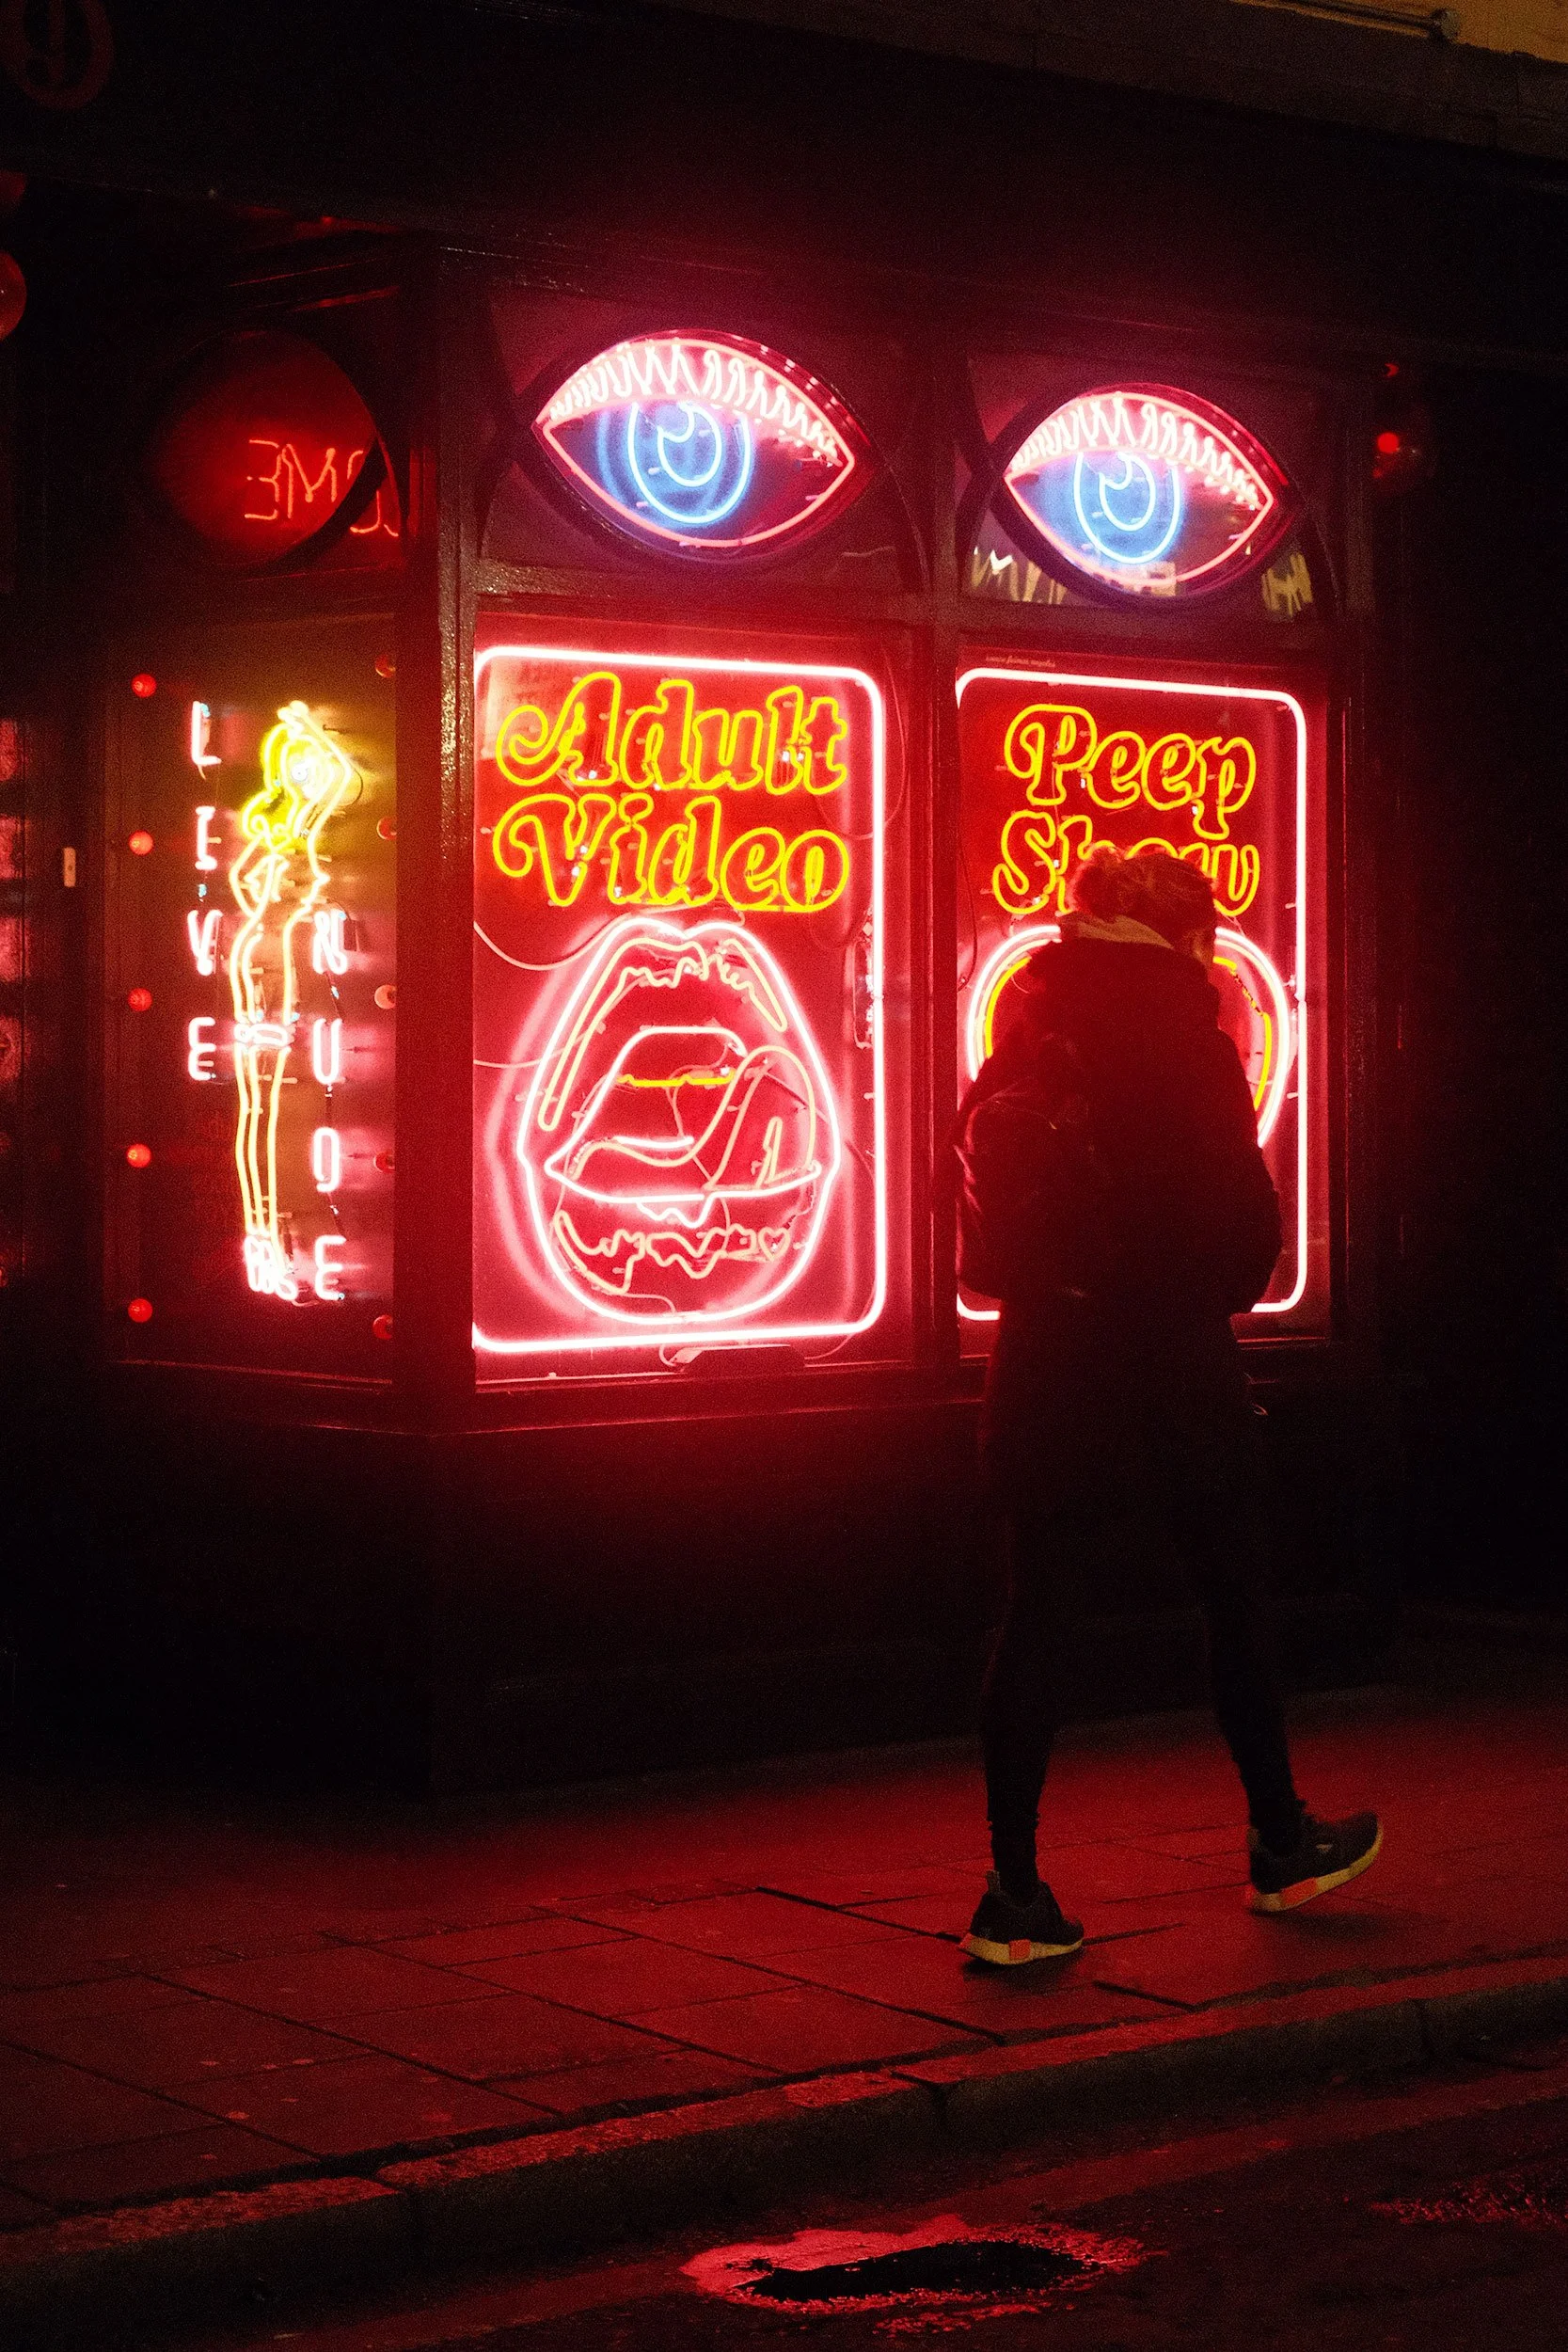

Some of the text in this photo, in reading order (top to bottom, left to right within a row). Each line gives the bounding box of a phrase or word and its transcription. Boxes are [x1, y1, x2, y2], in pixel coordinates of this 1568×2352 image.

[496, 671, 848, 795] Adult
[1004, 703, 1257, 840] Peep
[187, 700, 223, 1081] LIVE
[492, 793, 850, 913] Video
[991, 809, 1260, 915] Shw
[312, 909, 348, 1301] NUDE
